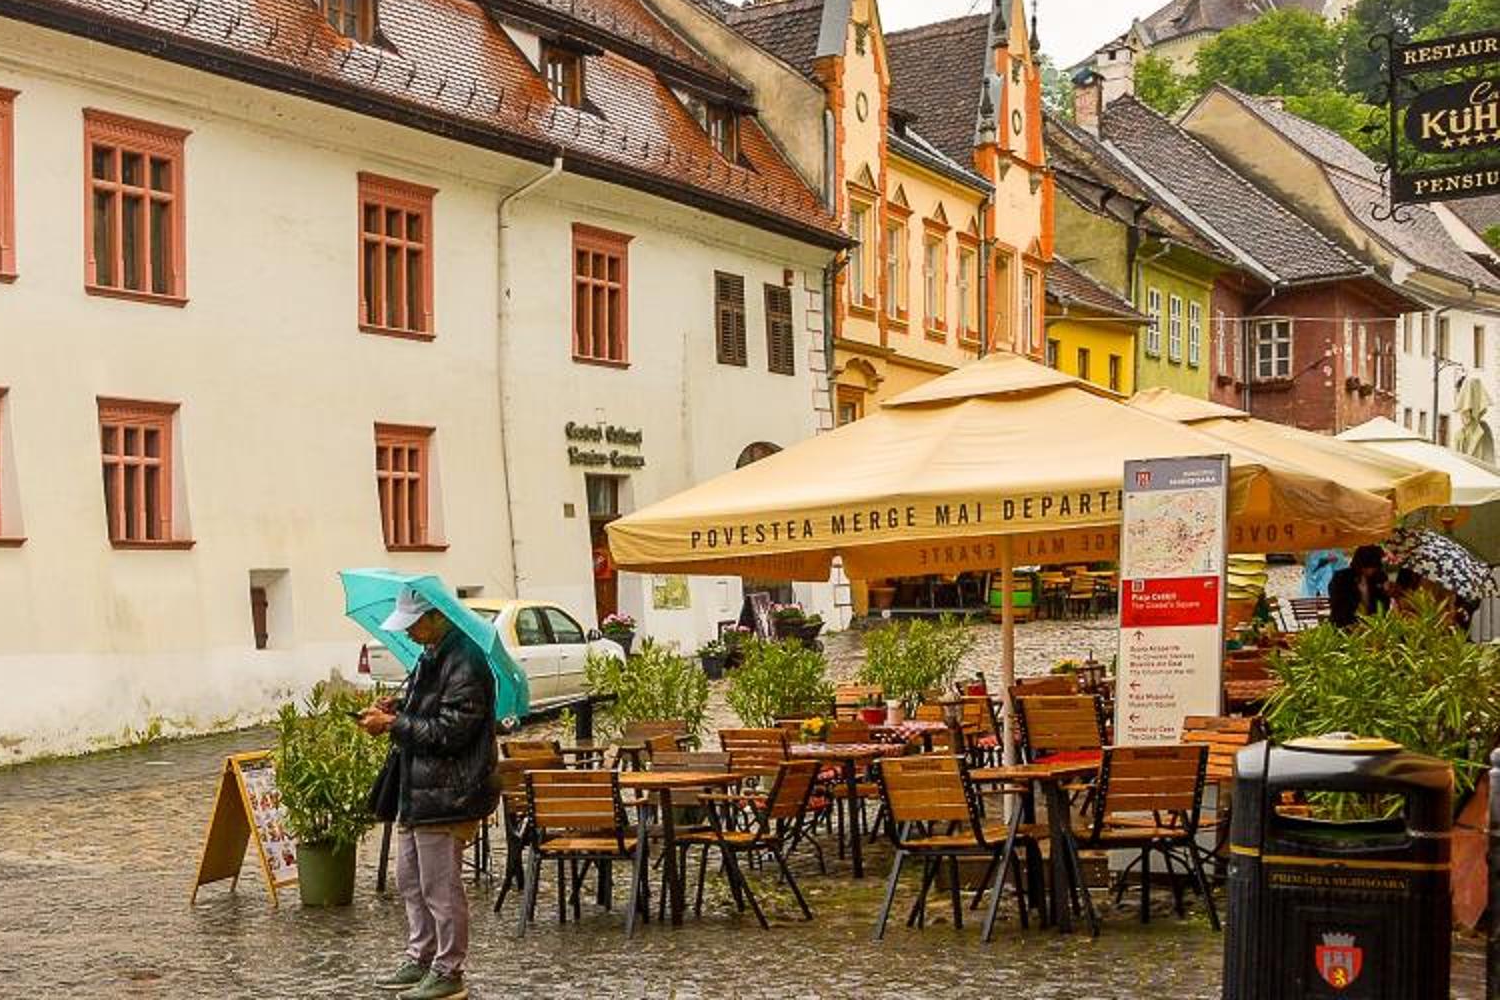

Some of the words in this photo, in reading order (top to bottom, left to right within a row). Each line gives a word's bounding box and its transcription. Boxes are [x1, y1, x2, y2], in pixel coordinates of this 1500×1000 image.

[1404, 37, 1498, 65] RESTAUR
[1414, 171, 1499, 194] PENSIU
[691, 518, 814, 549] POVESTEA
[831, 506, 916, 535] MERGE
[935, 501, 982, 527] MAI
